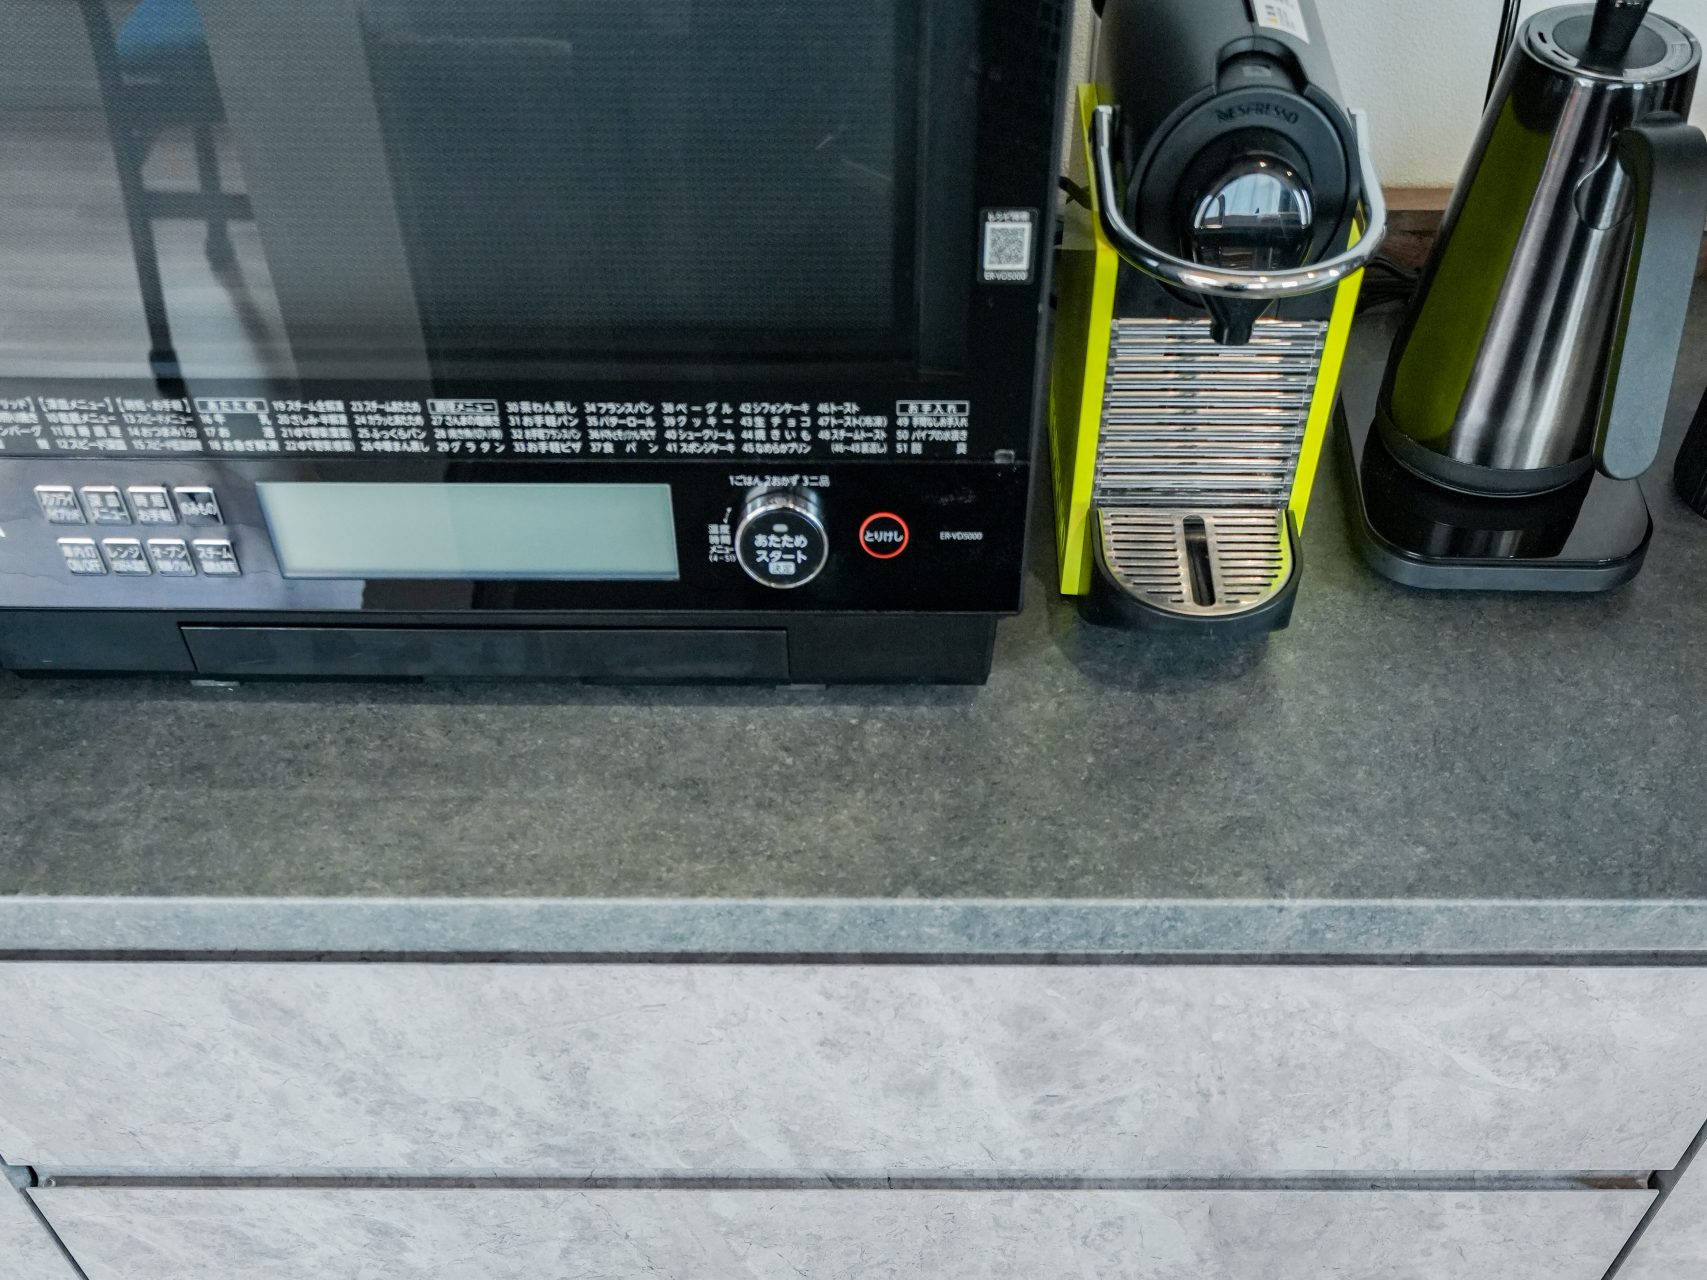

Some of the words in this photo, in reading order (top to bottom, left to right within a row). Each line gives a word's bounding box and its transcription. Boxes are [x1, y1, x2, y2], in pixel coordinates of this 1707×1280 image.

[1216, 103, 1299, 124] NESPRESSO
[984, 272, 1028, 280] ER-VD5000
[754, 533, 808, 548] あたため
[864, 529, 904, 543] とりけし
[939, 531, 983, 541] ER-VD5000
[756, 549, 807, 564] スタート
